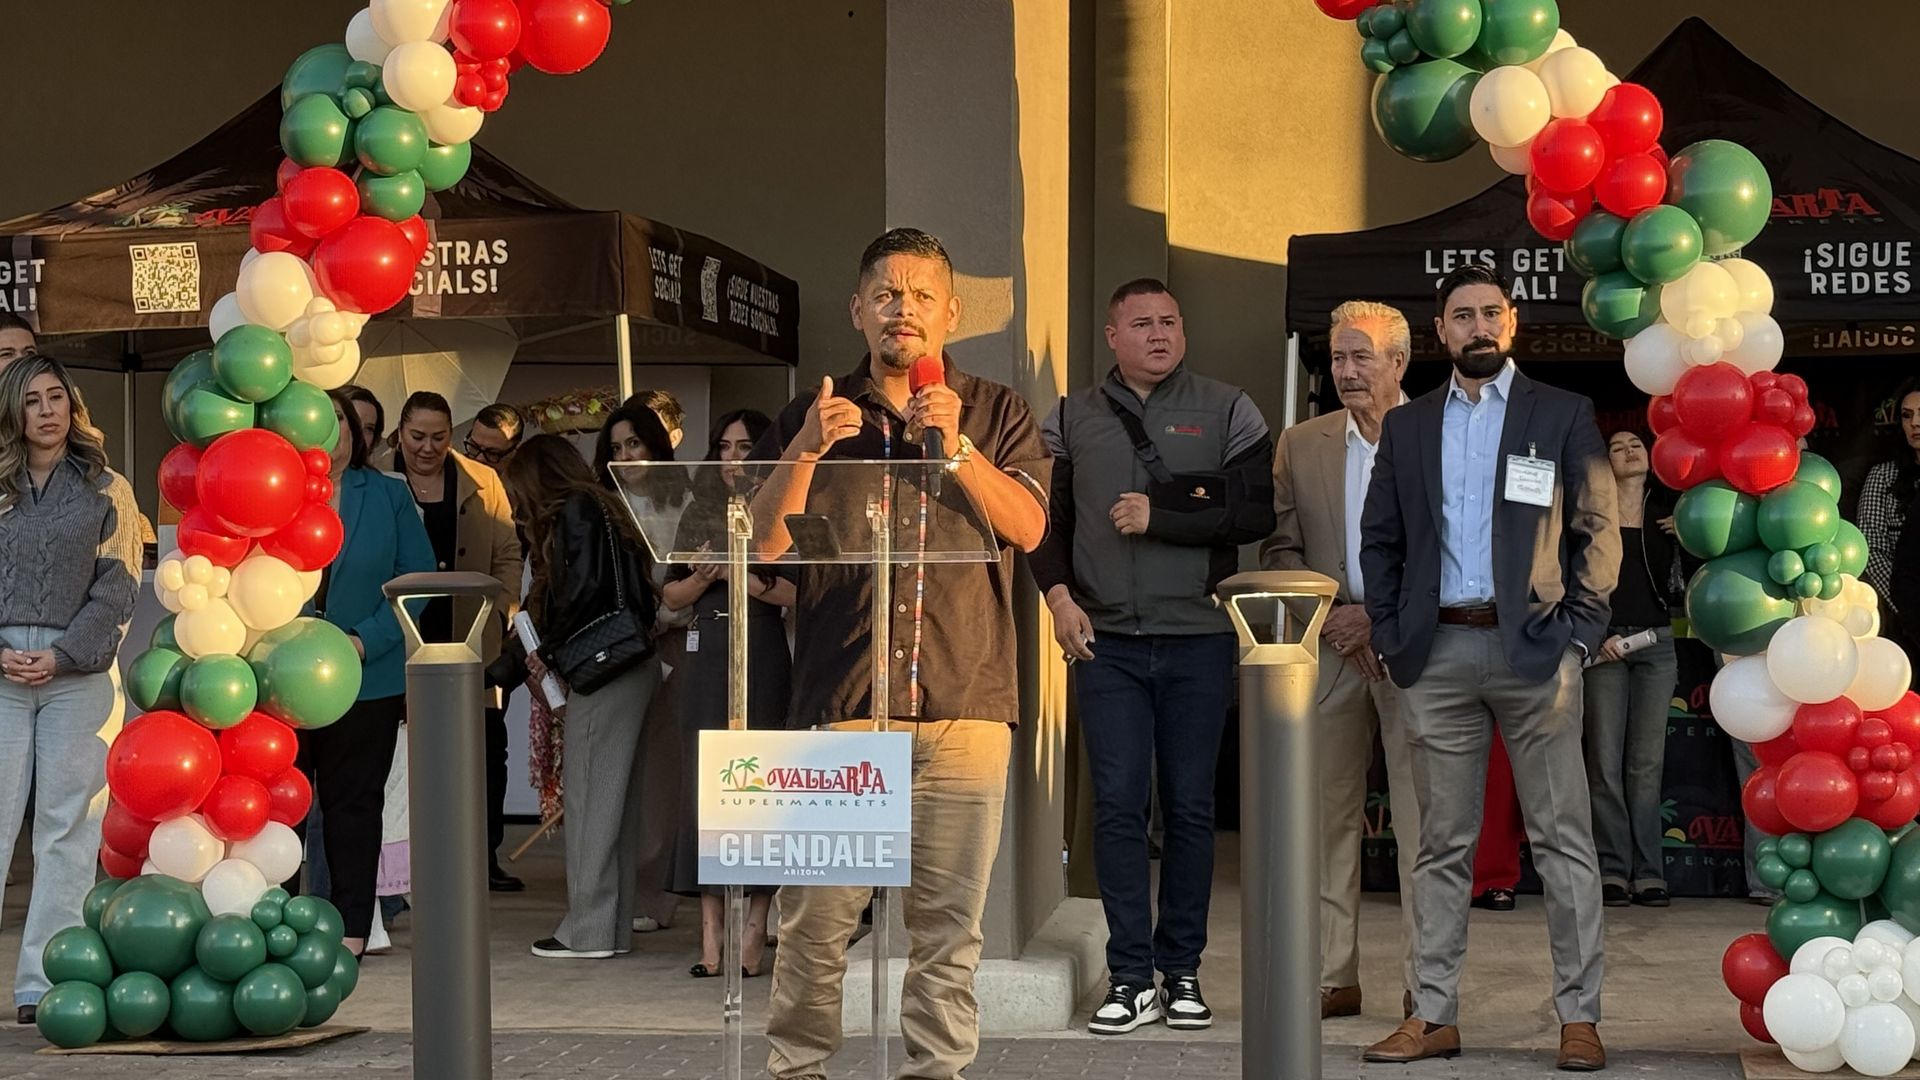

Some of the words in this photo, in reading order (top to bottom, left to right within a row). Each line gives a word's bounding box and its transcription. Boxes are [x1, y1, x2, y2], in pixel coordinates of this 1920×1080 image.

[1772, 188, 1880, 218] ARTA
[420, 239, 508, 267] STRAS
[648, 246, 667, 275] LETS
[668, 253, 684, 279] GET
[1425, 249, 1496, 274] LETS
[1512, 248, 1564, 273] GET
[1804, 242, 1912, 273] ¡SIGUE
[0, 258, 46, 285] GET
[408, 268, 498, 296] CIALS!
[1810, 271, 1911, 295] REDES
[767, 761, 889, 796] VALLARTA
[720, 798, 888, 807] SUPERMARKETS
[718, 832, 895, 868] GLENDALE
